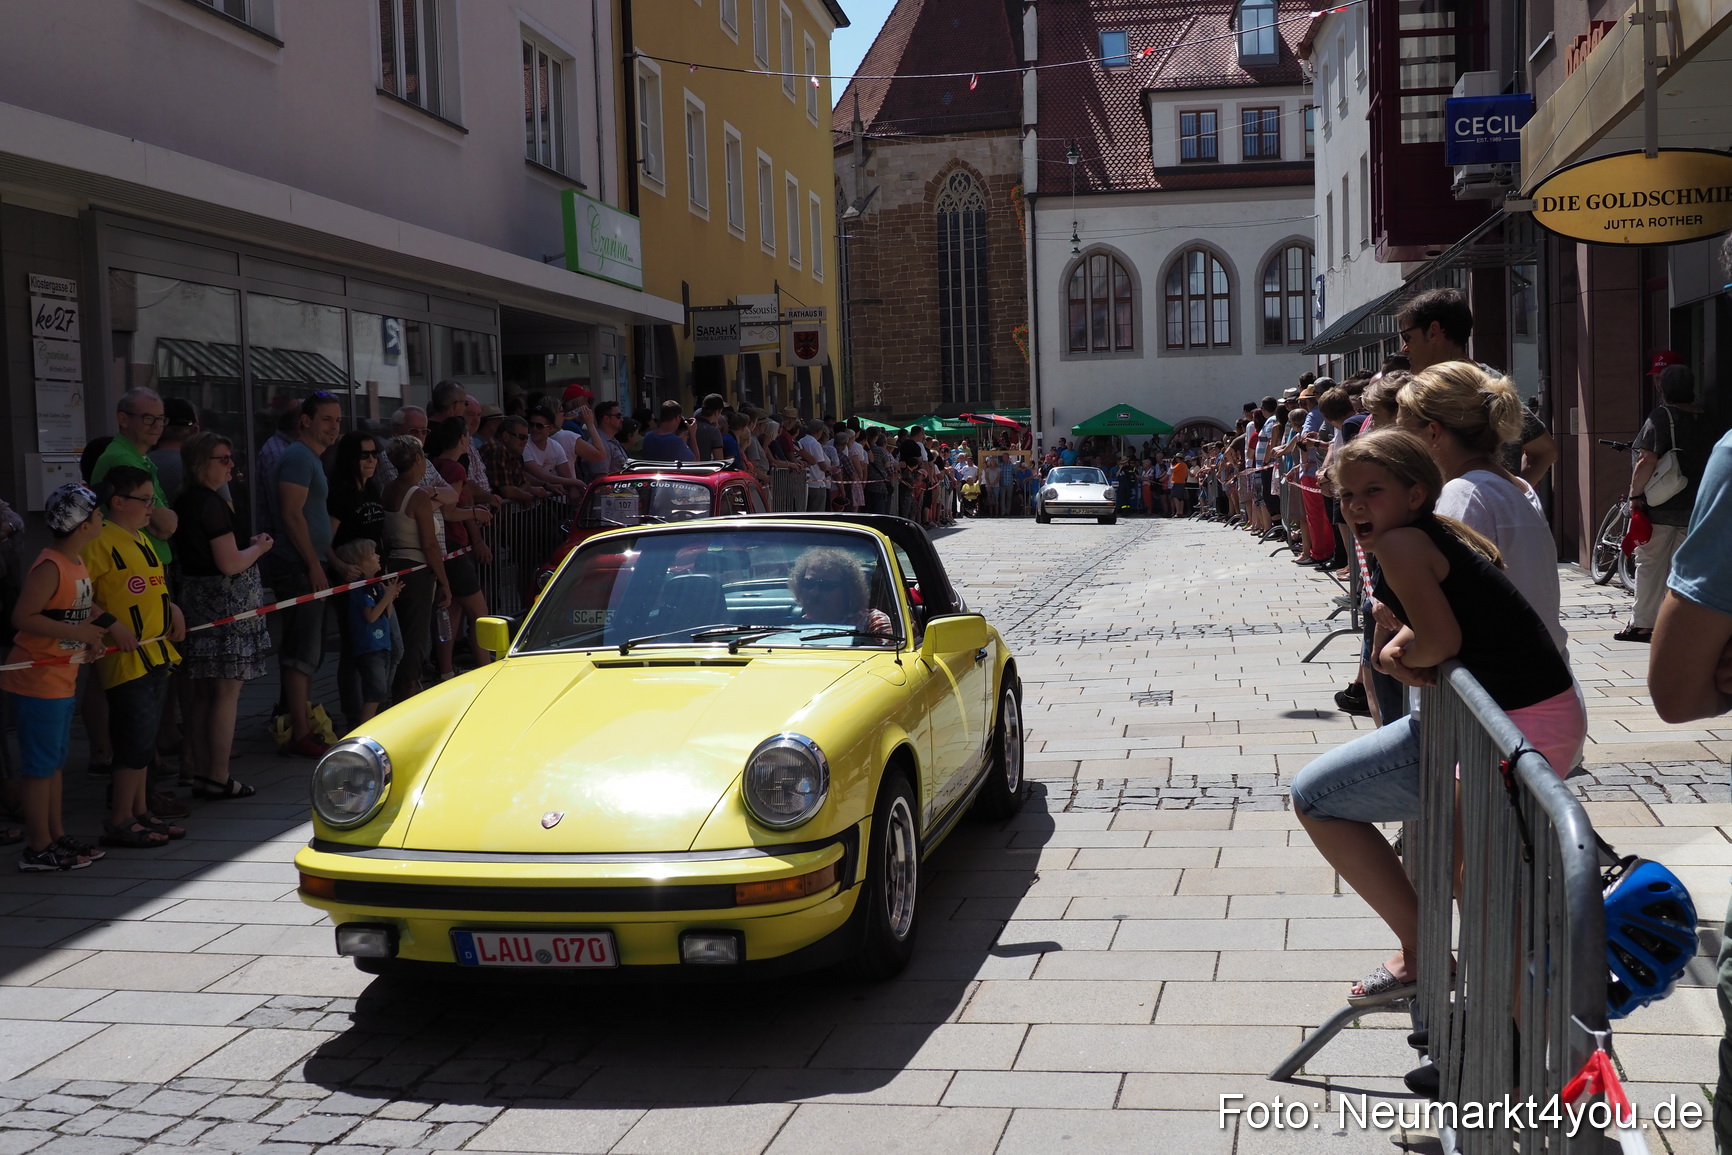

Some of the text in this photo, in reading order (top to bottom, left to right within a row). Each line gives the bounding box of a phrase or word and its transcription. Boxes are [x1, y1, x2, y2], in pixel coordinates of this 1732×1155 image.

[1455, 115, 1521, 136] CECIL
[1542, 195, 1580, 212] DIE
[1604, 214, 1703, 231] JUTTA ROTHER
[30, 276, 76, 293] Klostergasse 27
[35, 303, 76, 332] ke27
[789, 311, 818, 319] RATHAUS
[697, 324, 737, 336] SARAH K
[619, 501, 632, 509] 107
[574, 611, 588, 623] SC
[596, 611, 603, 623] F
[477, 937, 533, 963] LAU
[552, 937, 606, 963] 070
